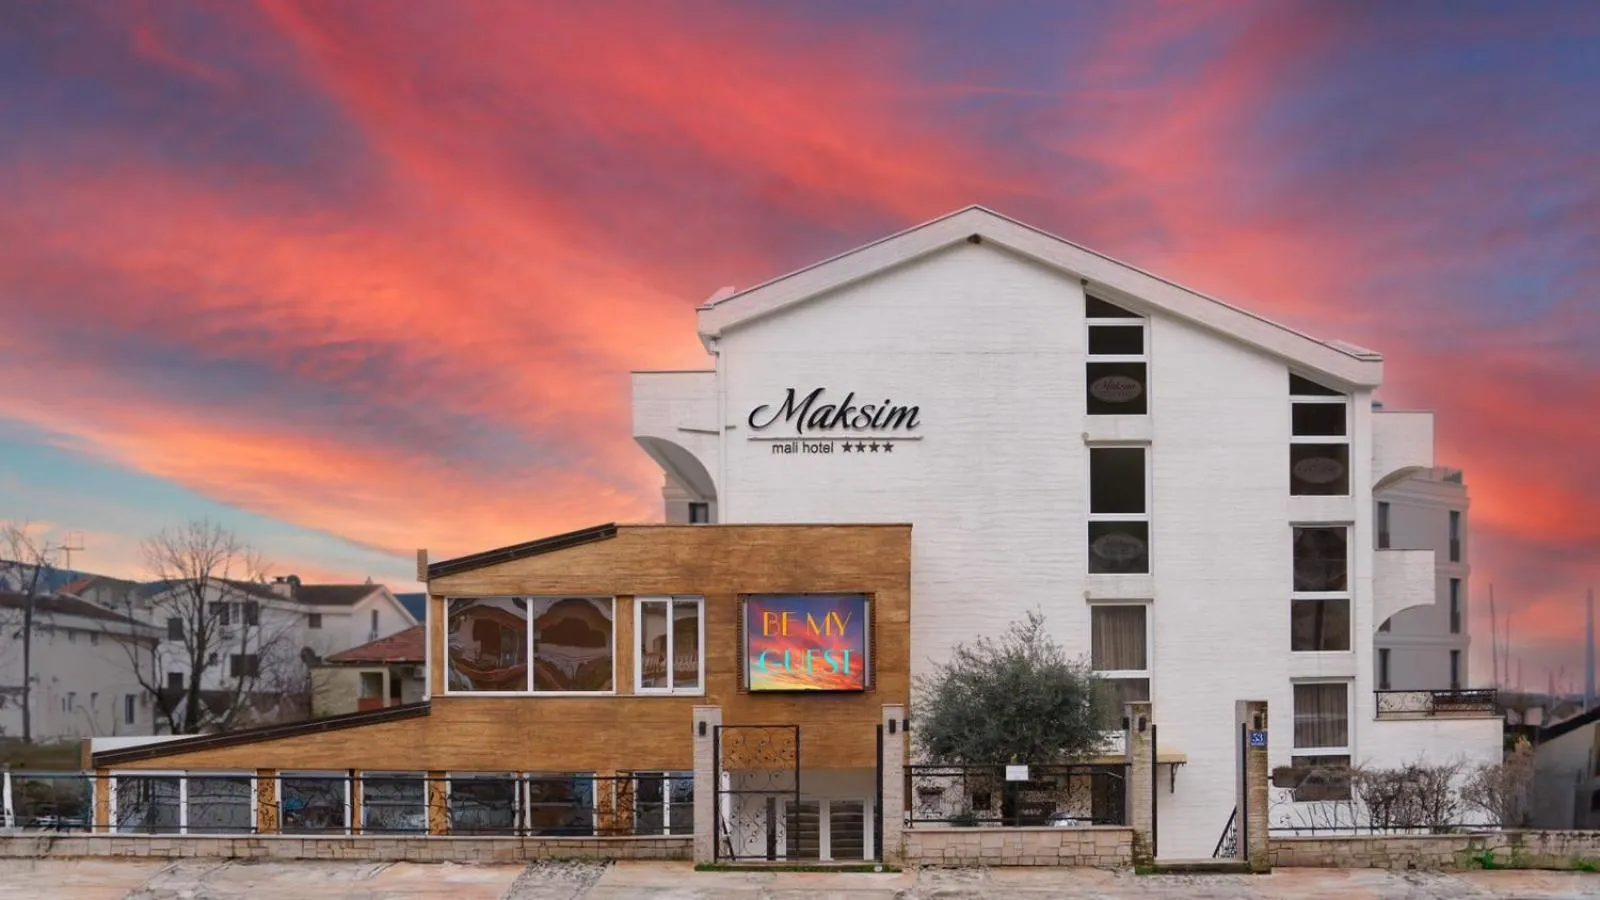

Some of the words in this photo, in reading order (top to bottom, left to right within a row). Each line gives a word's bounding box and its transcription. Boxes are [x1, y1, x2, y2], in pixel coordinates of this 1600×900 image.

[748, 387, 920, 435] Maksim
[772, 442, 798, 454] mali
[802, 442, 834, 454] hotel
[763, 611, 797, 637] BE
[806, 611, 853, 637] MY
[758, 648, 855, 676] GUEST
